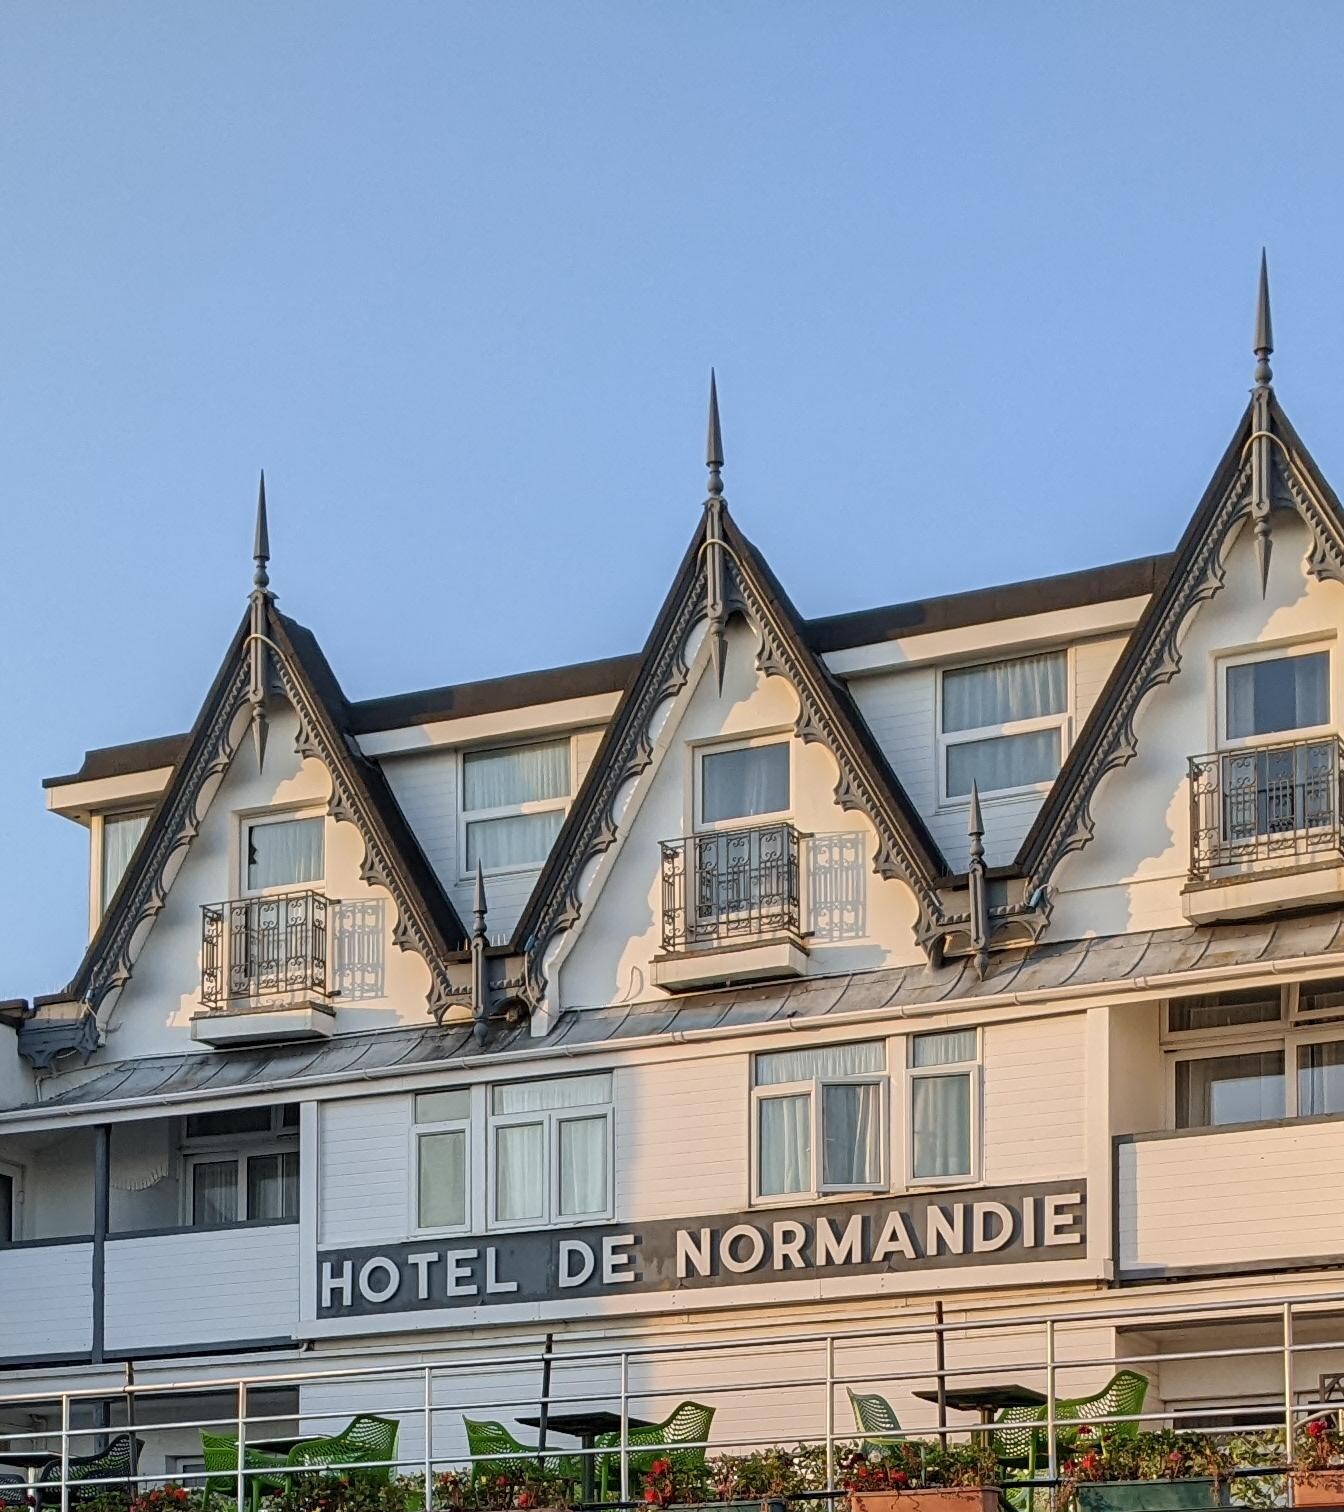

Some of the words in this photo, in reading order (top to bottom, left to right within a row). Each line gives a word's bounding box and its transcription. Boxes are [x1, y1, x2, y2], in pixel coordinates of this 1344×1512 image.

[321, 1247, 518, 1308] HOTEL
[558, 1234, 635, 1288] DE
[676, 1193, 1081, 1278] NORMANDIE
